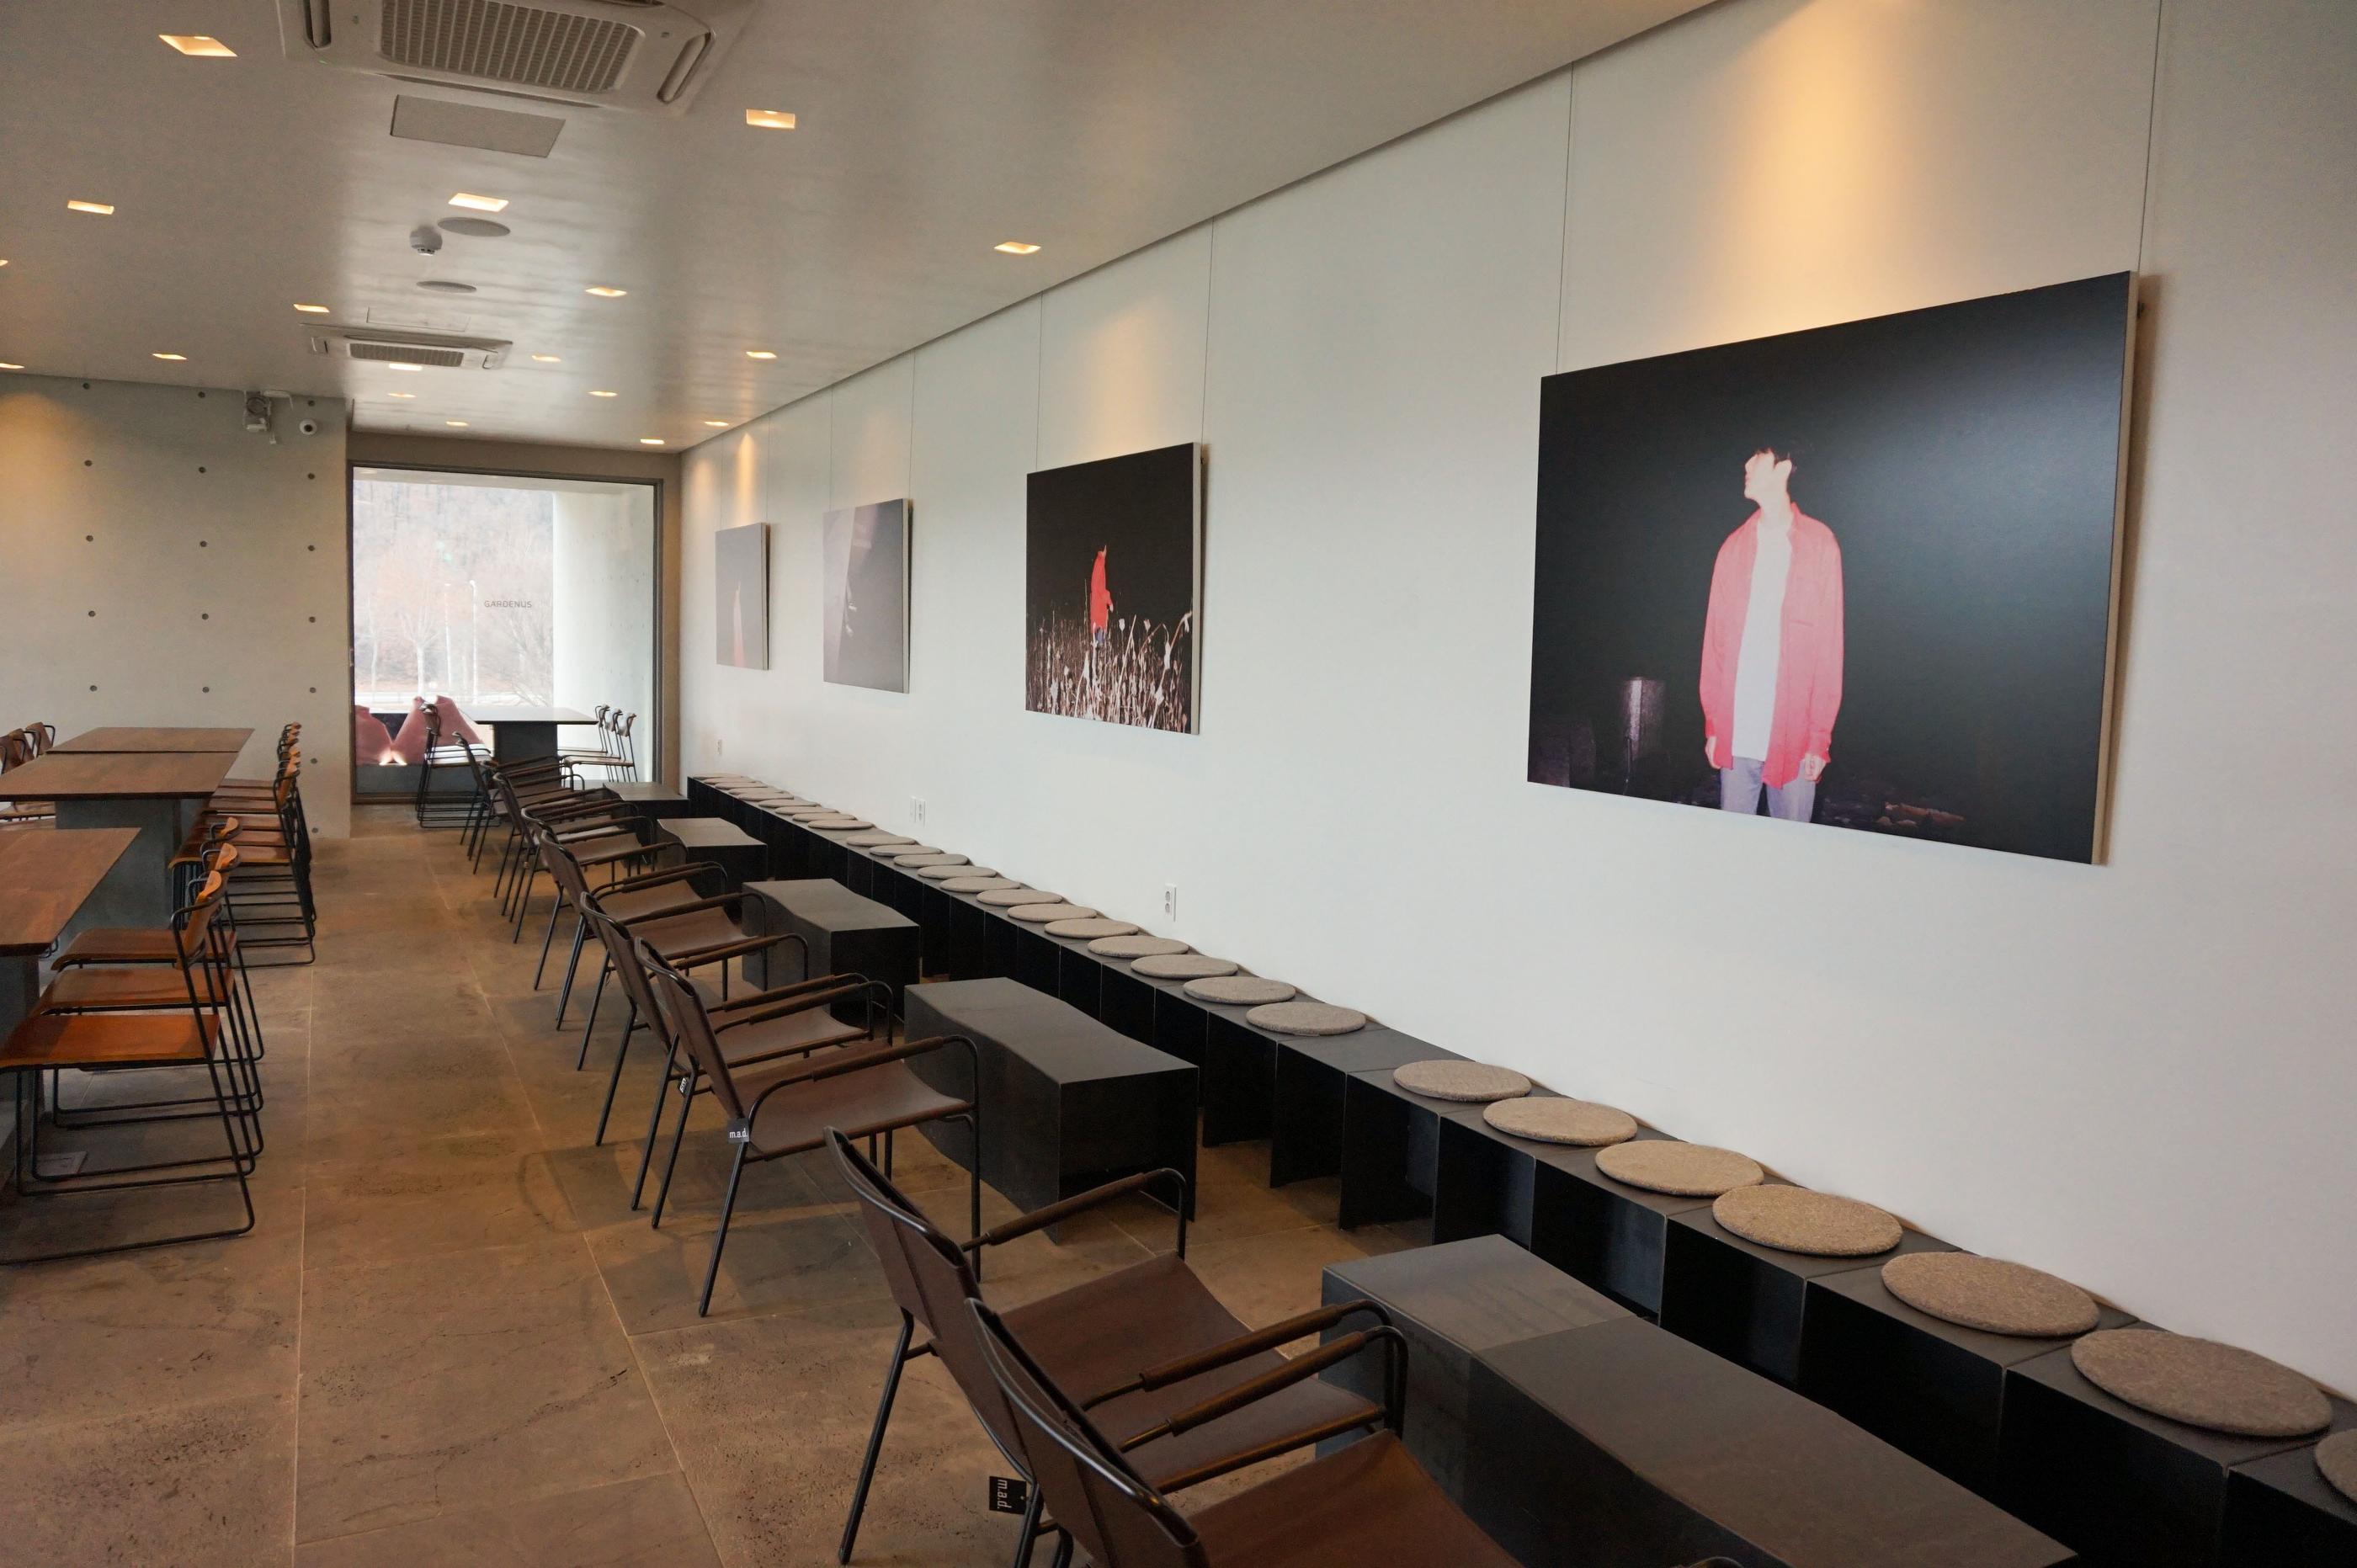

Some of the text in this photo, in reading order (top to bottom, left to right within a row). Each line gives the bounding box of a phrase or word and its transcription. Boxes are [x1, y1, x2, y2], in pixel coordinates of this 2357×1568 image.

[483, 600, 533, 609] GARDENUS
[729, 1128, 748, 1139] m.a.d.
[997, 1479, 1013, 1509] m.a.d.
